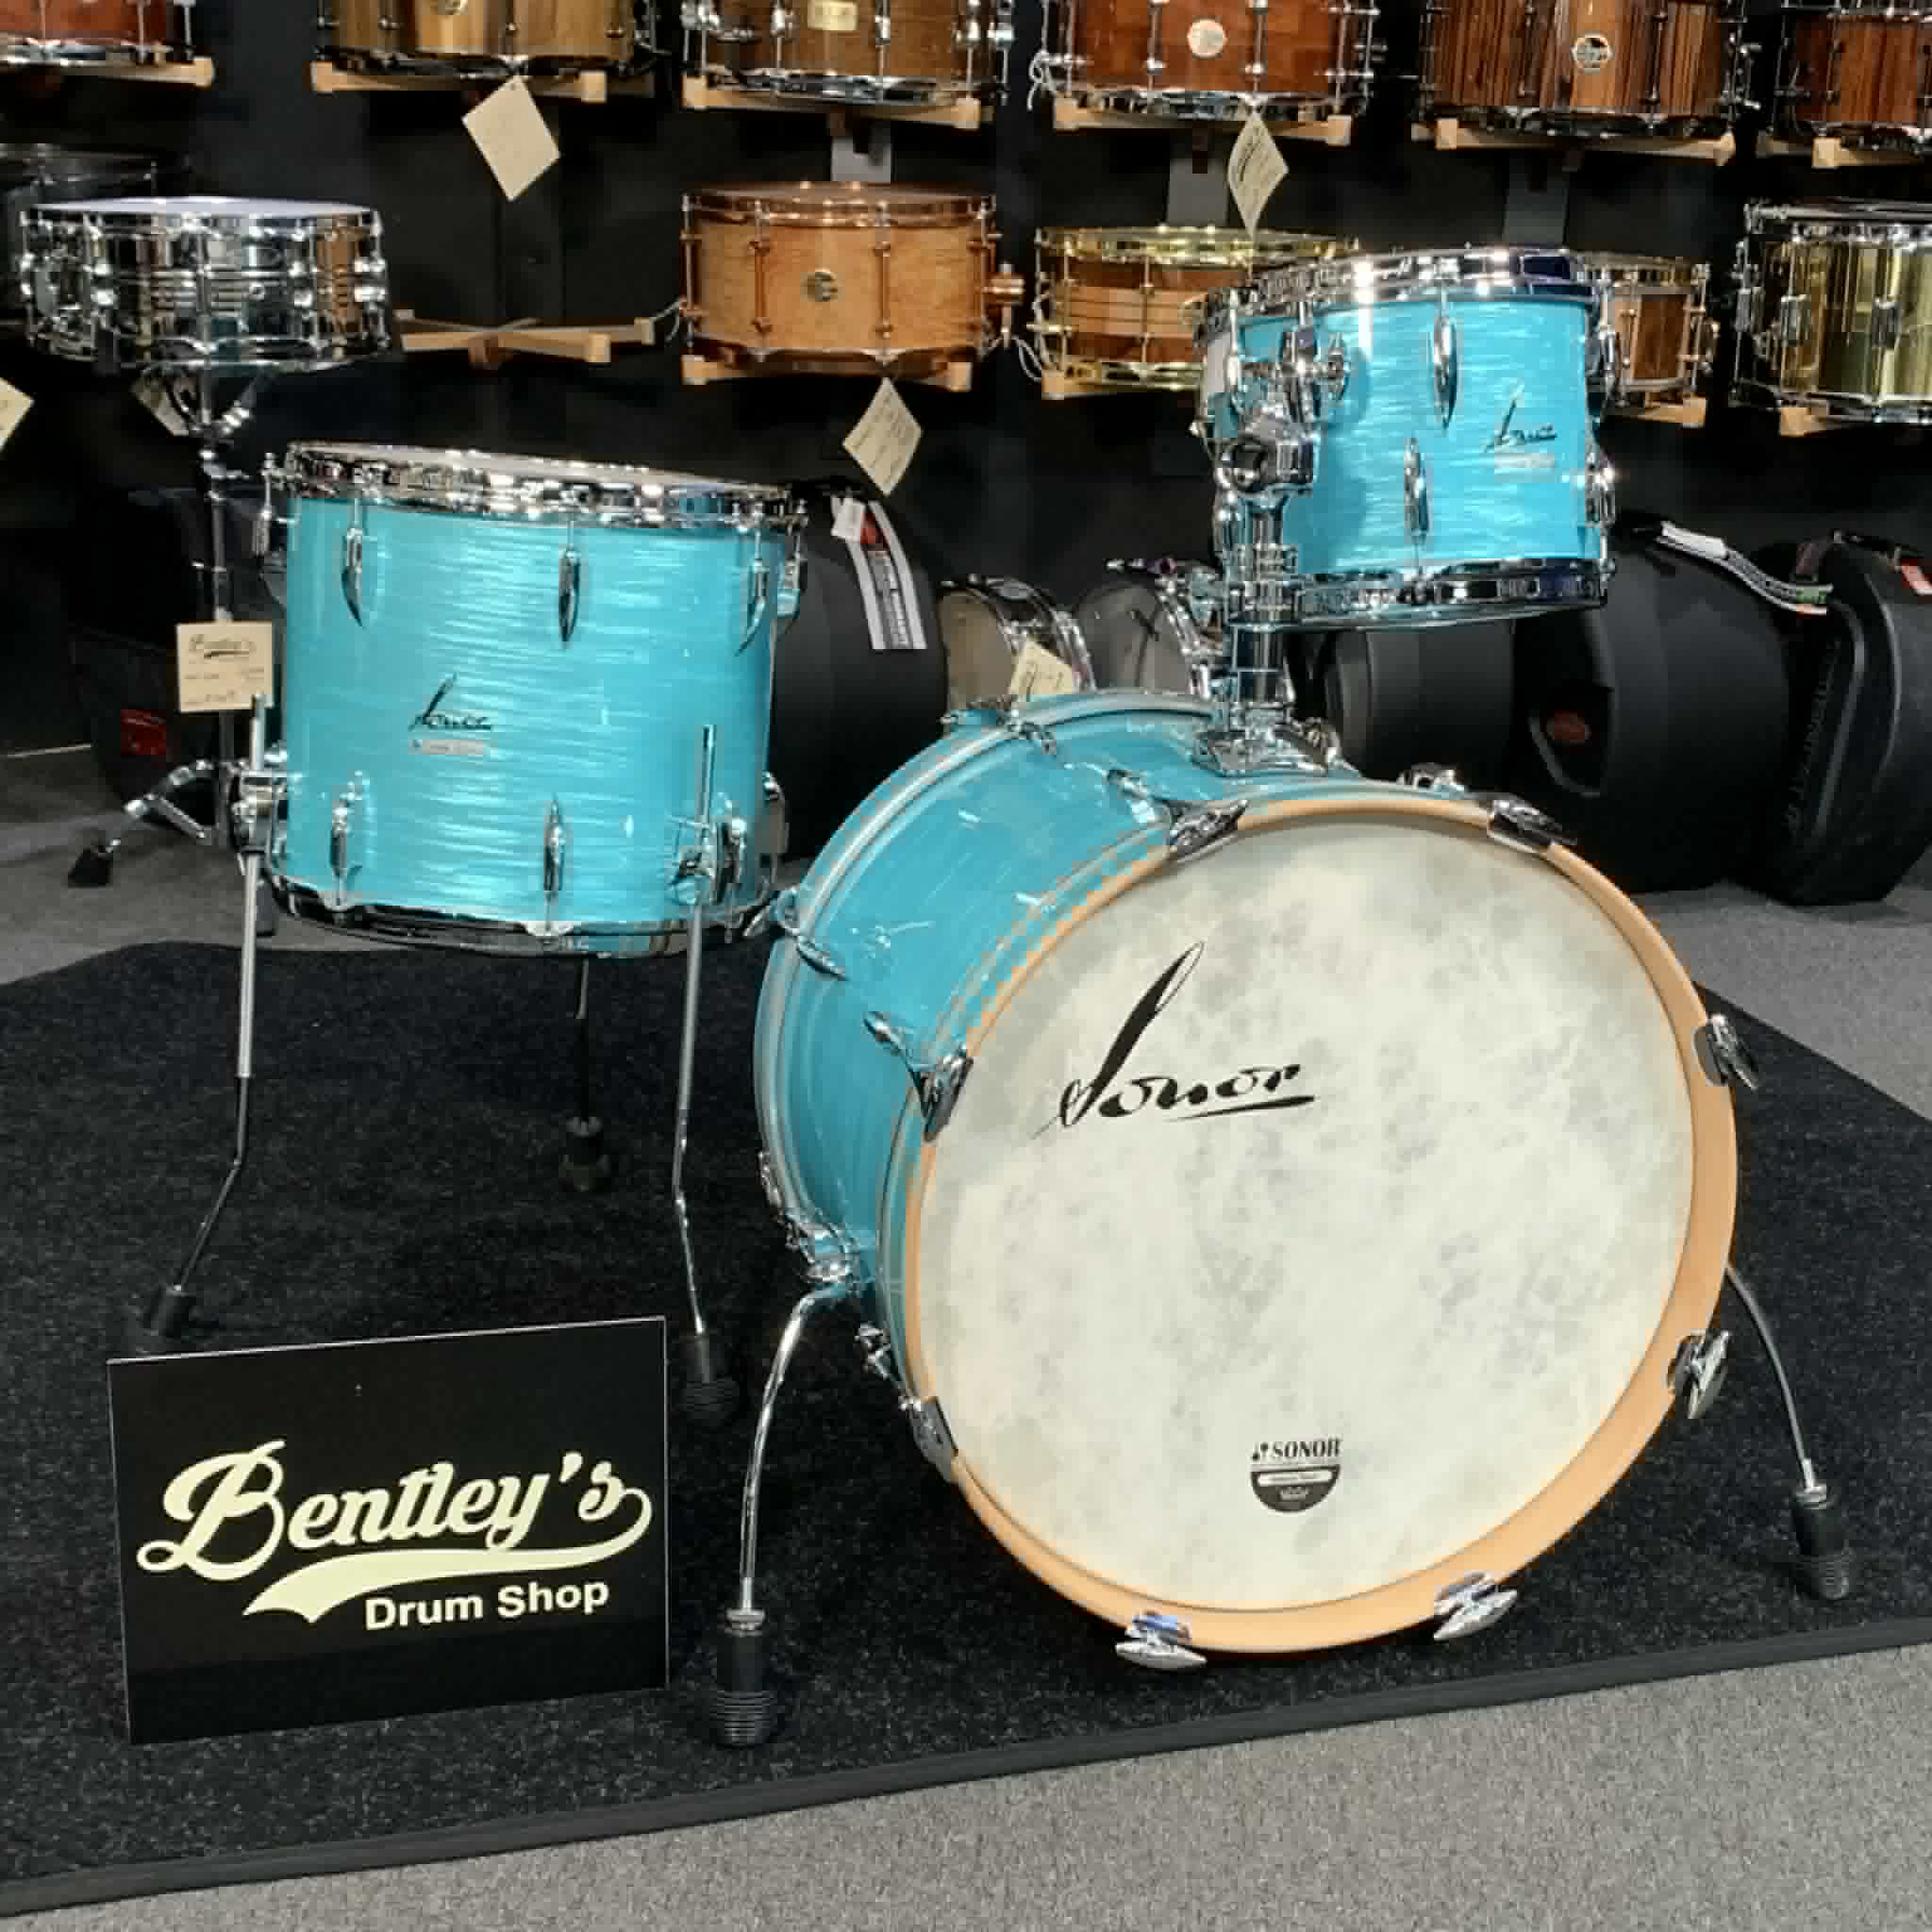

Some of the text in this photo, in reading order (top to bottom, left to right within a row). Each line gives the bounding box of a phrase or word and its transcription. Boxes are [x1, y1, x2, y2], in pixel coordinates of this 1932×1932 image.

[1033, 941, 1315, 1140] Sonor
[1271, 1437, 1341, 1461] SONOR
[137, 1439, 652, 1580] Bentley's
[365, 1580, 609, 1630] Drum Shop
